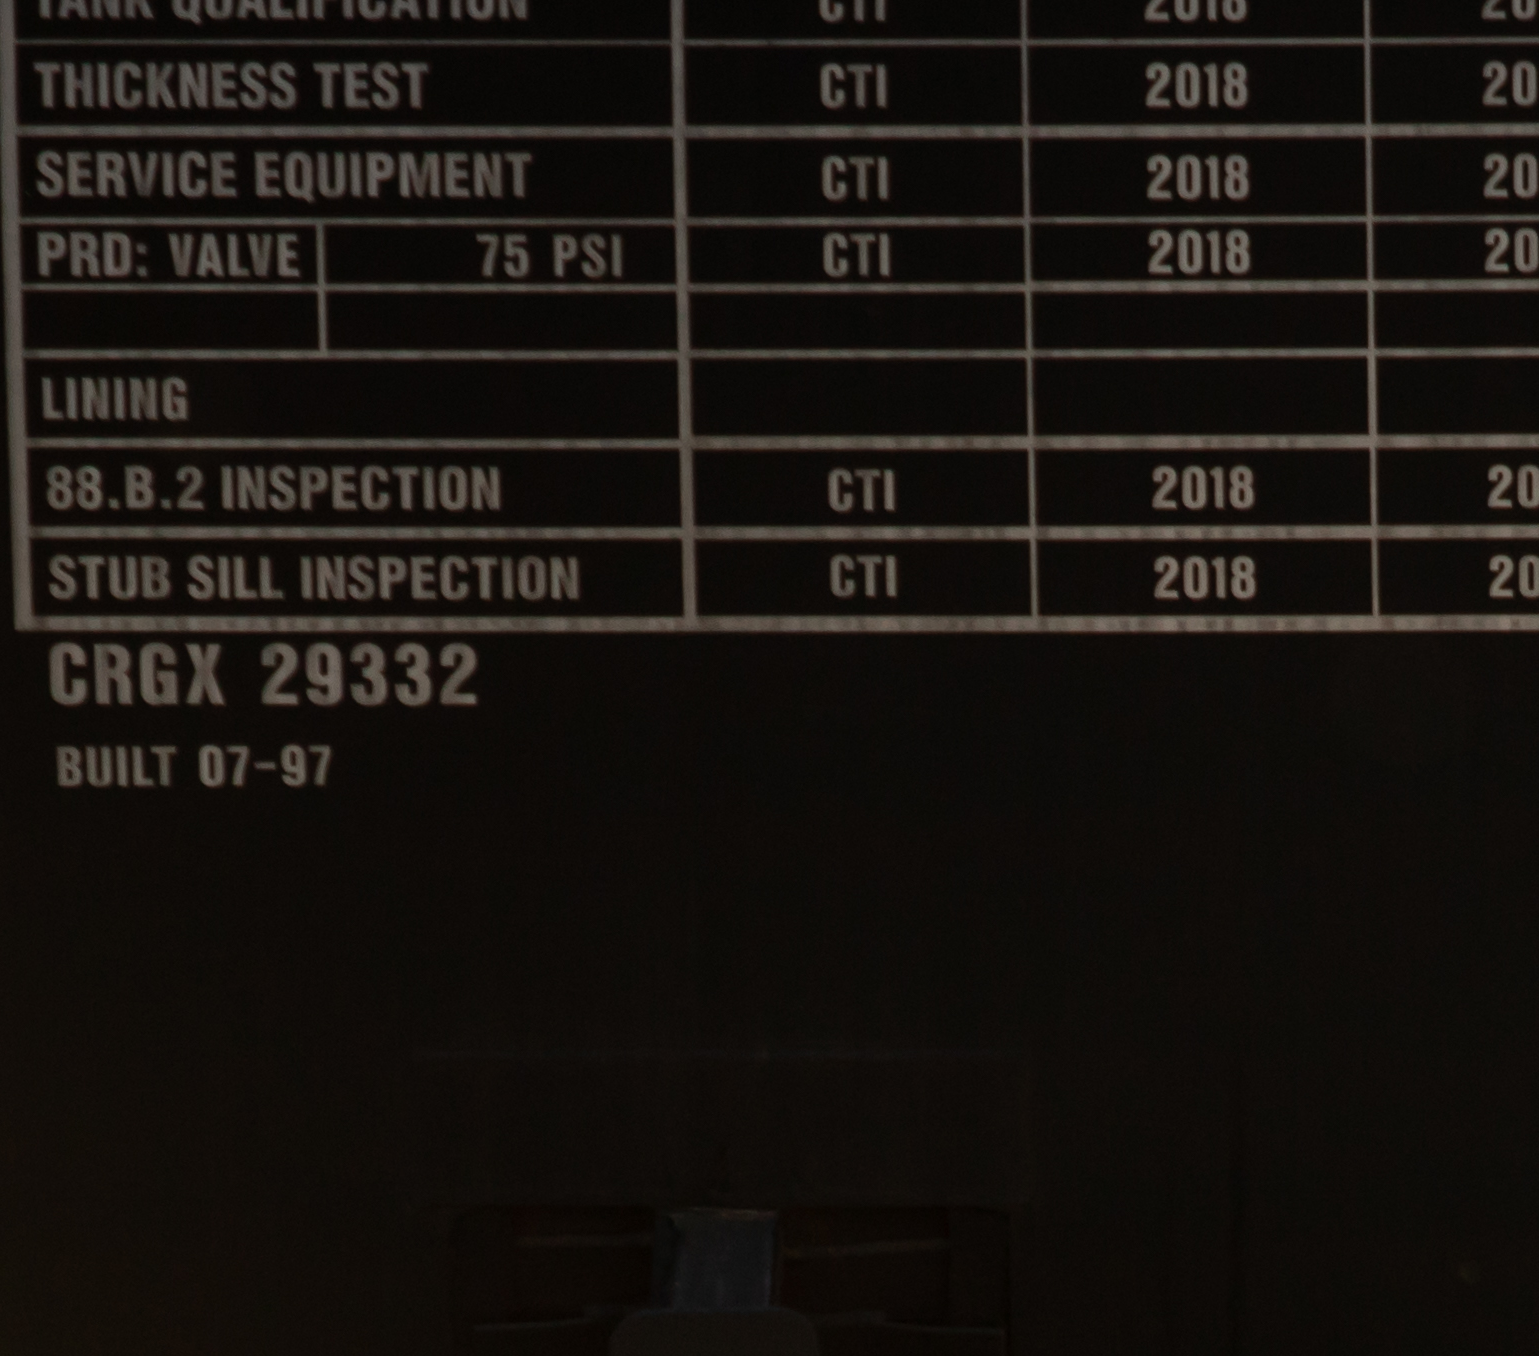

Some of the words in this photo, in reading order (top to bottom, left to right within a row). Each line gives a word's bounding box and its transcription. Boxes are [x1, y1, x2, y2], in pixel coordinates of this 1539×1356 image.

[33, 61, 298, 110] THICKNESS
[312, 61, 429, 110] TEST
[819, 62, 888, 109] CTI
[1145, 61, 1249, 109] 2018
[36, 149, 238, 198] SERVICE
[254, 150, 532, 203] EQUIPMENT
[821, 155, 890, 201] CTI
[1146, 153, 1250, 201] 2018
[37, 231, 148, 277] PRD:
[168, 232, 300, 278] VALVE
[476, 233, 530, 278] 75
[552, 233, 623, 279] PSI
[822, 232, 891, 278] CTI
[1148, 228, 1251, 276] 2018
[41, 375, 189, 422] LINING
[46, 464, 205, 511] 88.B.2
[221, 464, 501, 512] INSPECTION
[827, 467, 896, 513] CTI
[1151, 465, 1255, 510] 2018
[48, 554, 172, 600] STUB
[187, 554, 284, 601] SILL
[300, 554, 580, 601] INSPECTION
[830, 554, 898, 598] CTI
[1153, 555, 1257, 600] 2018
[49, 641, 225, 706] CRGX
[261, 642, 478, 707] 29332
[56, 745, 177, 788] BUILT
[198, 743, 332, 788] 07-97
